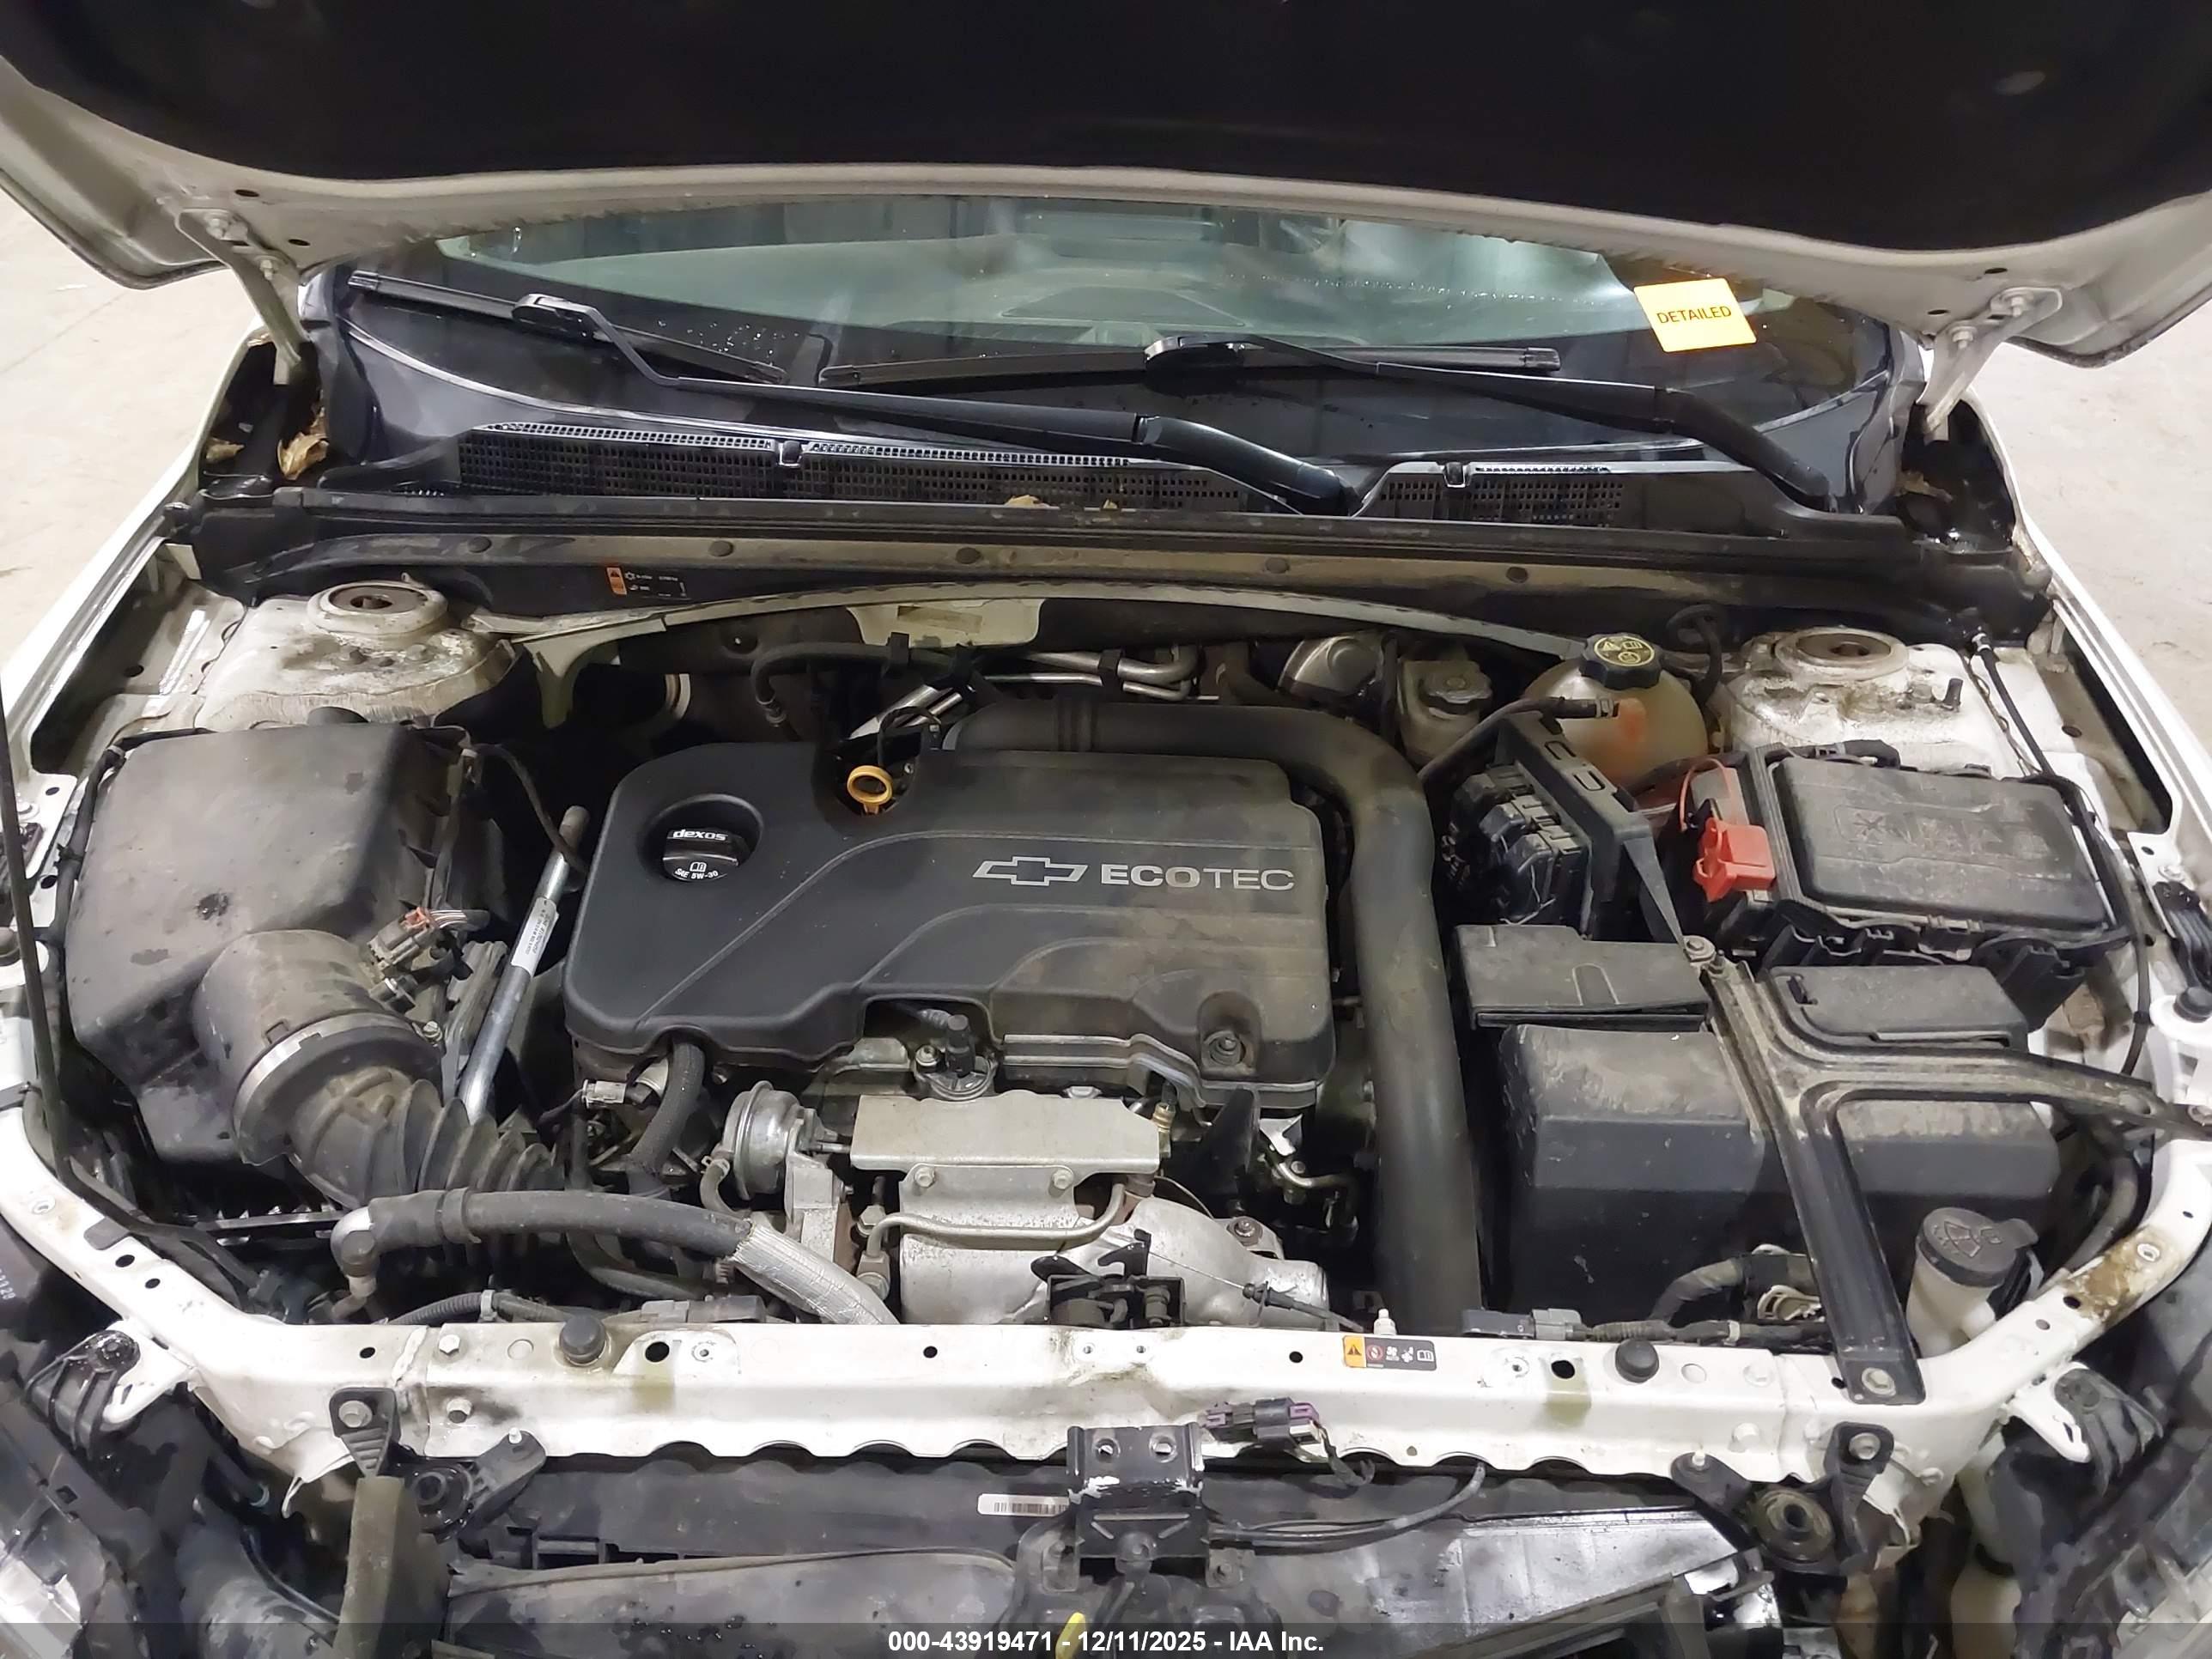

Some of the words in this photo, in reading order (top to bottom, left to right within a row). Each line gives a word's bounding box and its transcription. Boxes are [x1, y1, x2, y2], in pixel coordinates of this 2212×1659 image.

[1656, 306, 1732, 324] DETAILED
[672, 829, 729, 841] dexos
[674, 868, 690, 878] SAE
[690, 870, 719, 879] 5W-30
[1101, 864, 1295, 890] ECOTEC
